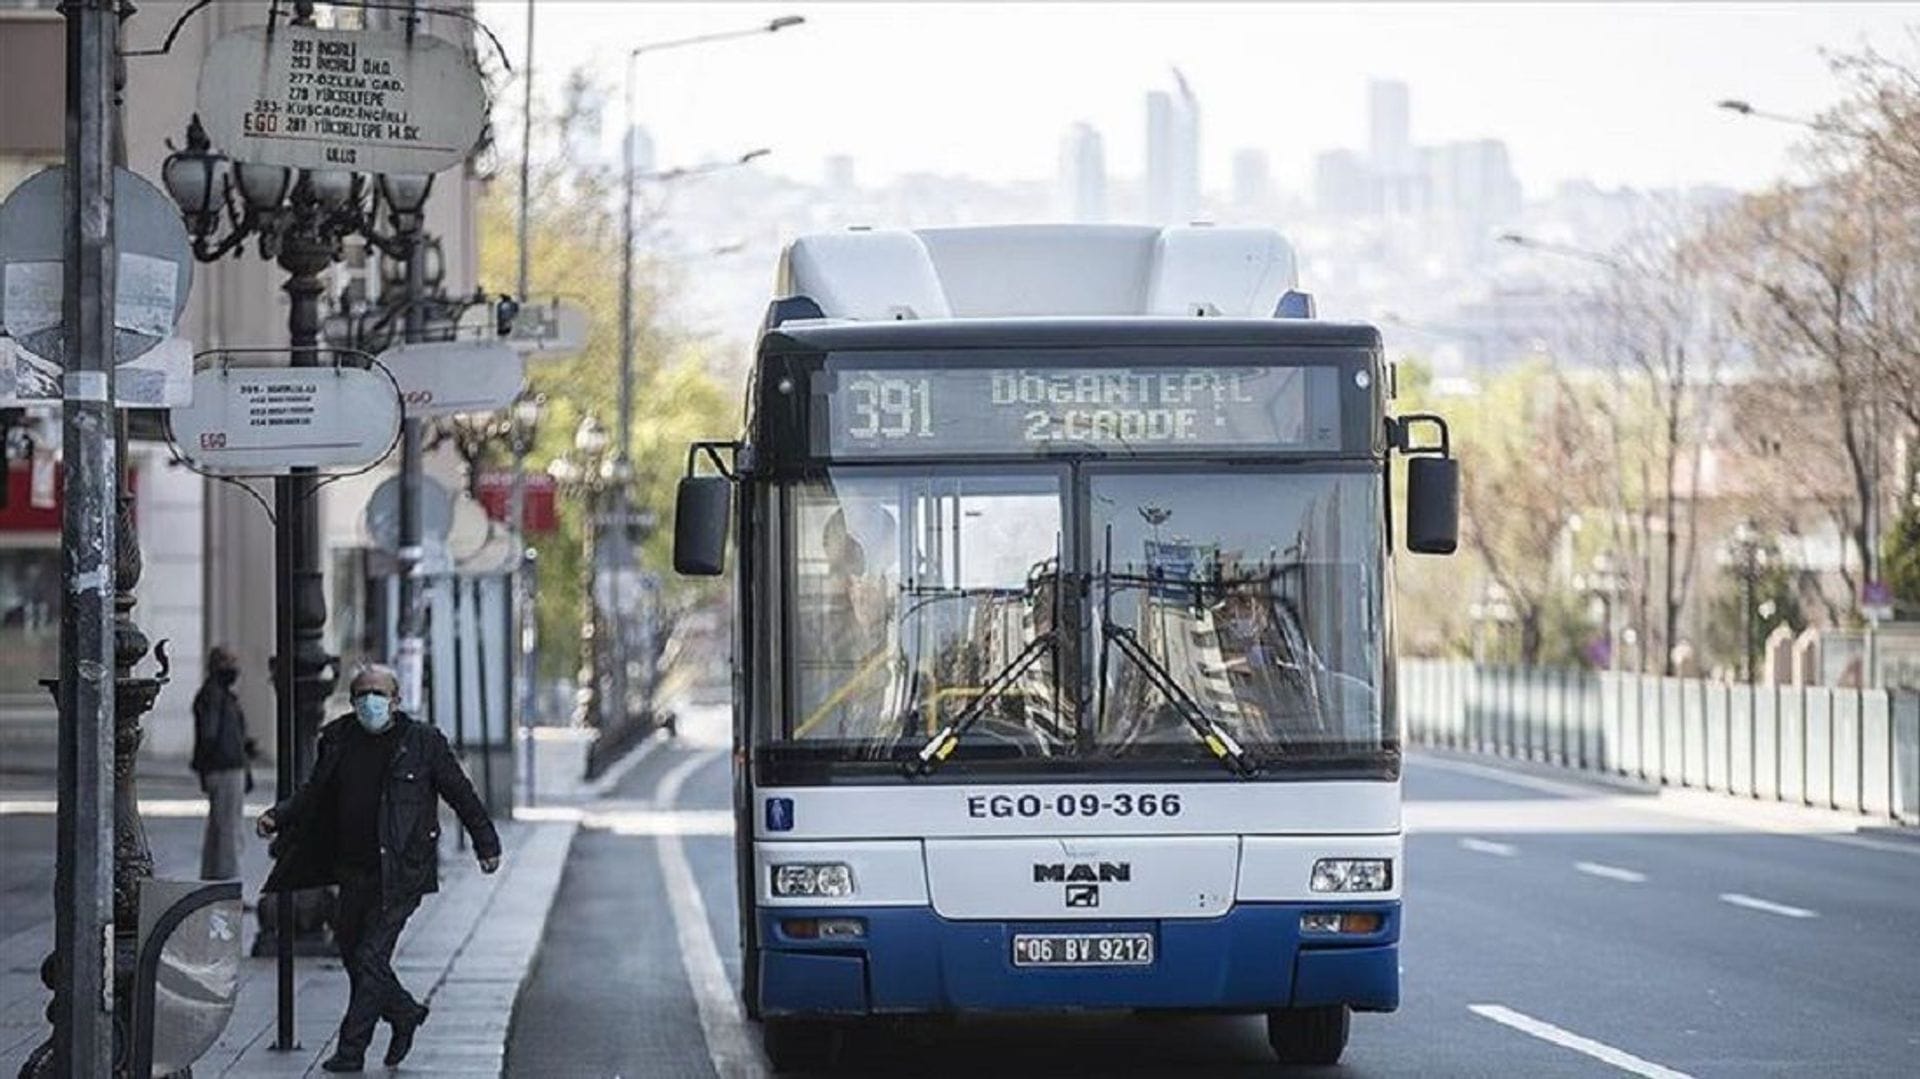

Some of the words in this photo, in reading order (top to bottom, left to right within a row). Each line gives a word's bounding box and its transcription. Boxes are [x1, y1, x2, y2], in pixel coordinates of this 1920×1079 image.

[244, 111, 278, 132] EGO
[326, 147, 357, 164] ULUS
[403, 391, 432, 404] GO
[849, 377, 935, 440] 391
[200, 433, 227, 448] EGO
[967, 793, 1182, 819] EGO-09-366
[1033, 863, 1131, 883] MAN
[1028, 938, 1052, 961] 06
[1065, 938, 1090, 961] BV
[1099, 938, 1148, 961] 9212
